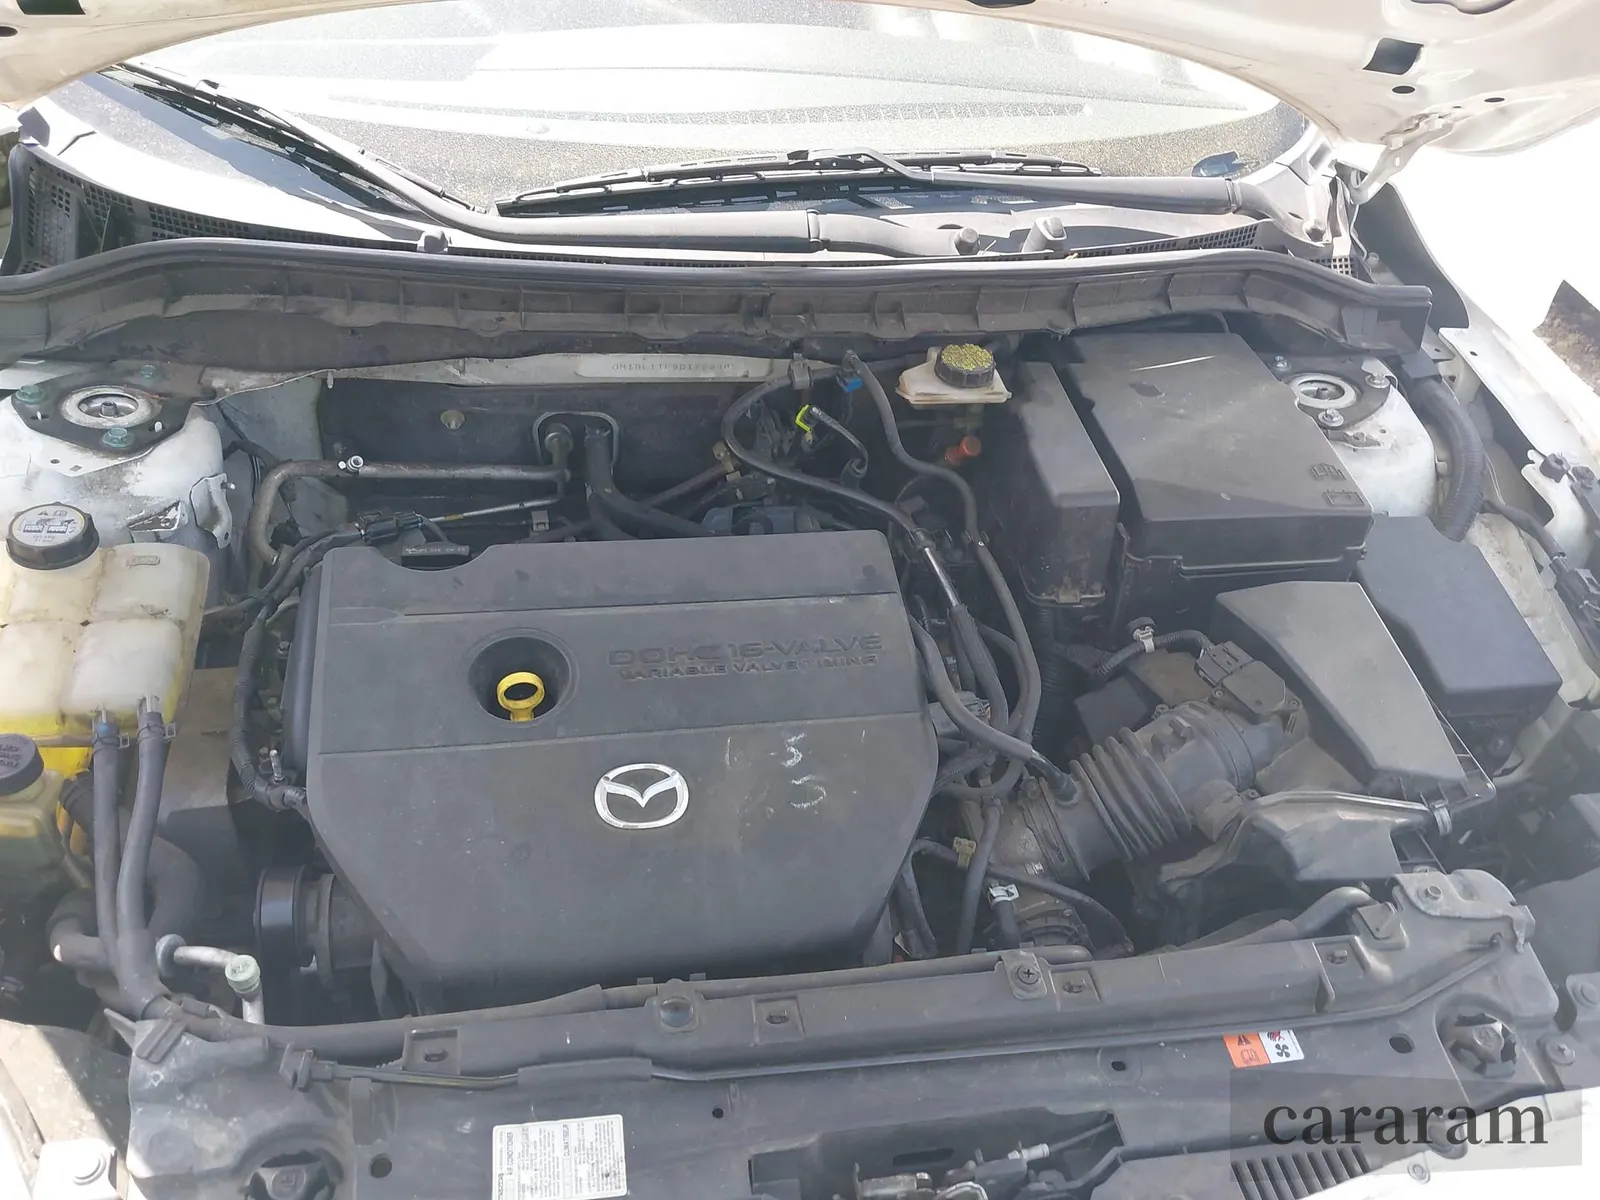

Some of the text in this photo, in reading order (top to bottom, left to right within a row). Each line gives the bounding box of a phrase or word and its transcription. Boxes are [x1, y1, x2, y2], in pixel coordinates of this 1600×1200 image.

[608, 633, 883, 666] DOHC 16-VALVE
[620, 664, 728, 681] VARIABLE
[732, 660, 799, 674] VALVE
